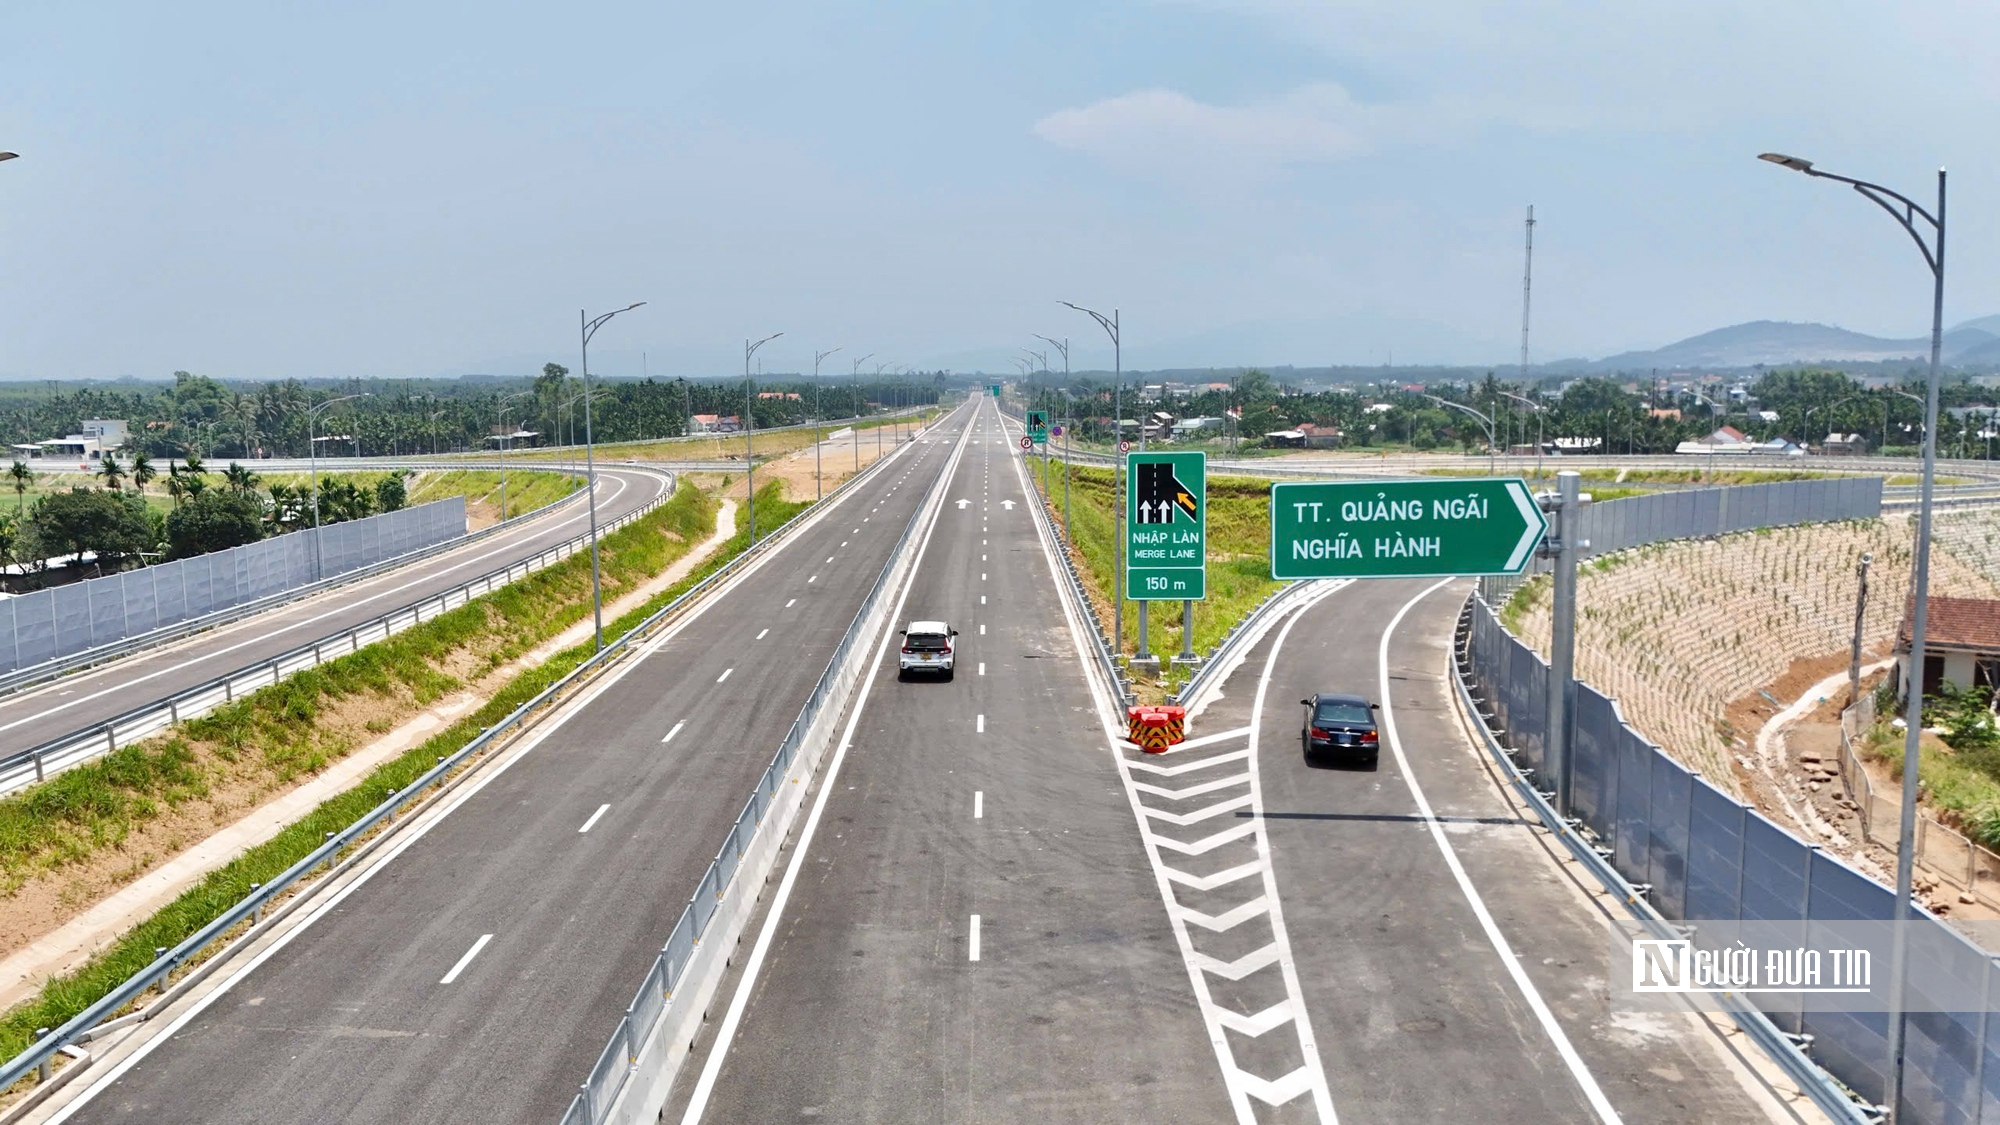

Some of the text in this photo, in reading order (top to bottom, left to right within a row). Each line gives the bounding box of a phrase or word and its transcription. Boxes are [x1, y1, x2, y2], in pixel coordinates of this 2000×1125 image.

[1293, 492, 1488, 523] TT. QUẢNG NGÃI
[1132, 529, 1199, 547] NHẬP LÀN
[1293, 531, 1441, 559] NGHĨA HÀNH
[1134, 549, 1196, 559] MERGE LANE
[1145, 576, 1186, 590] 150 m
